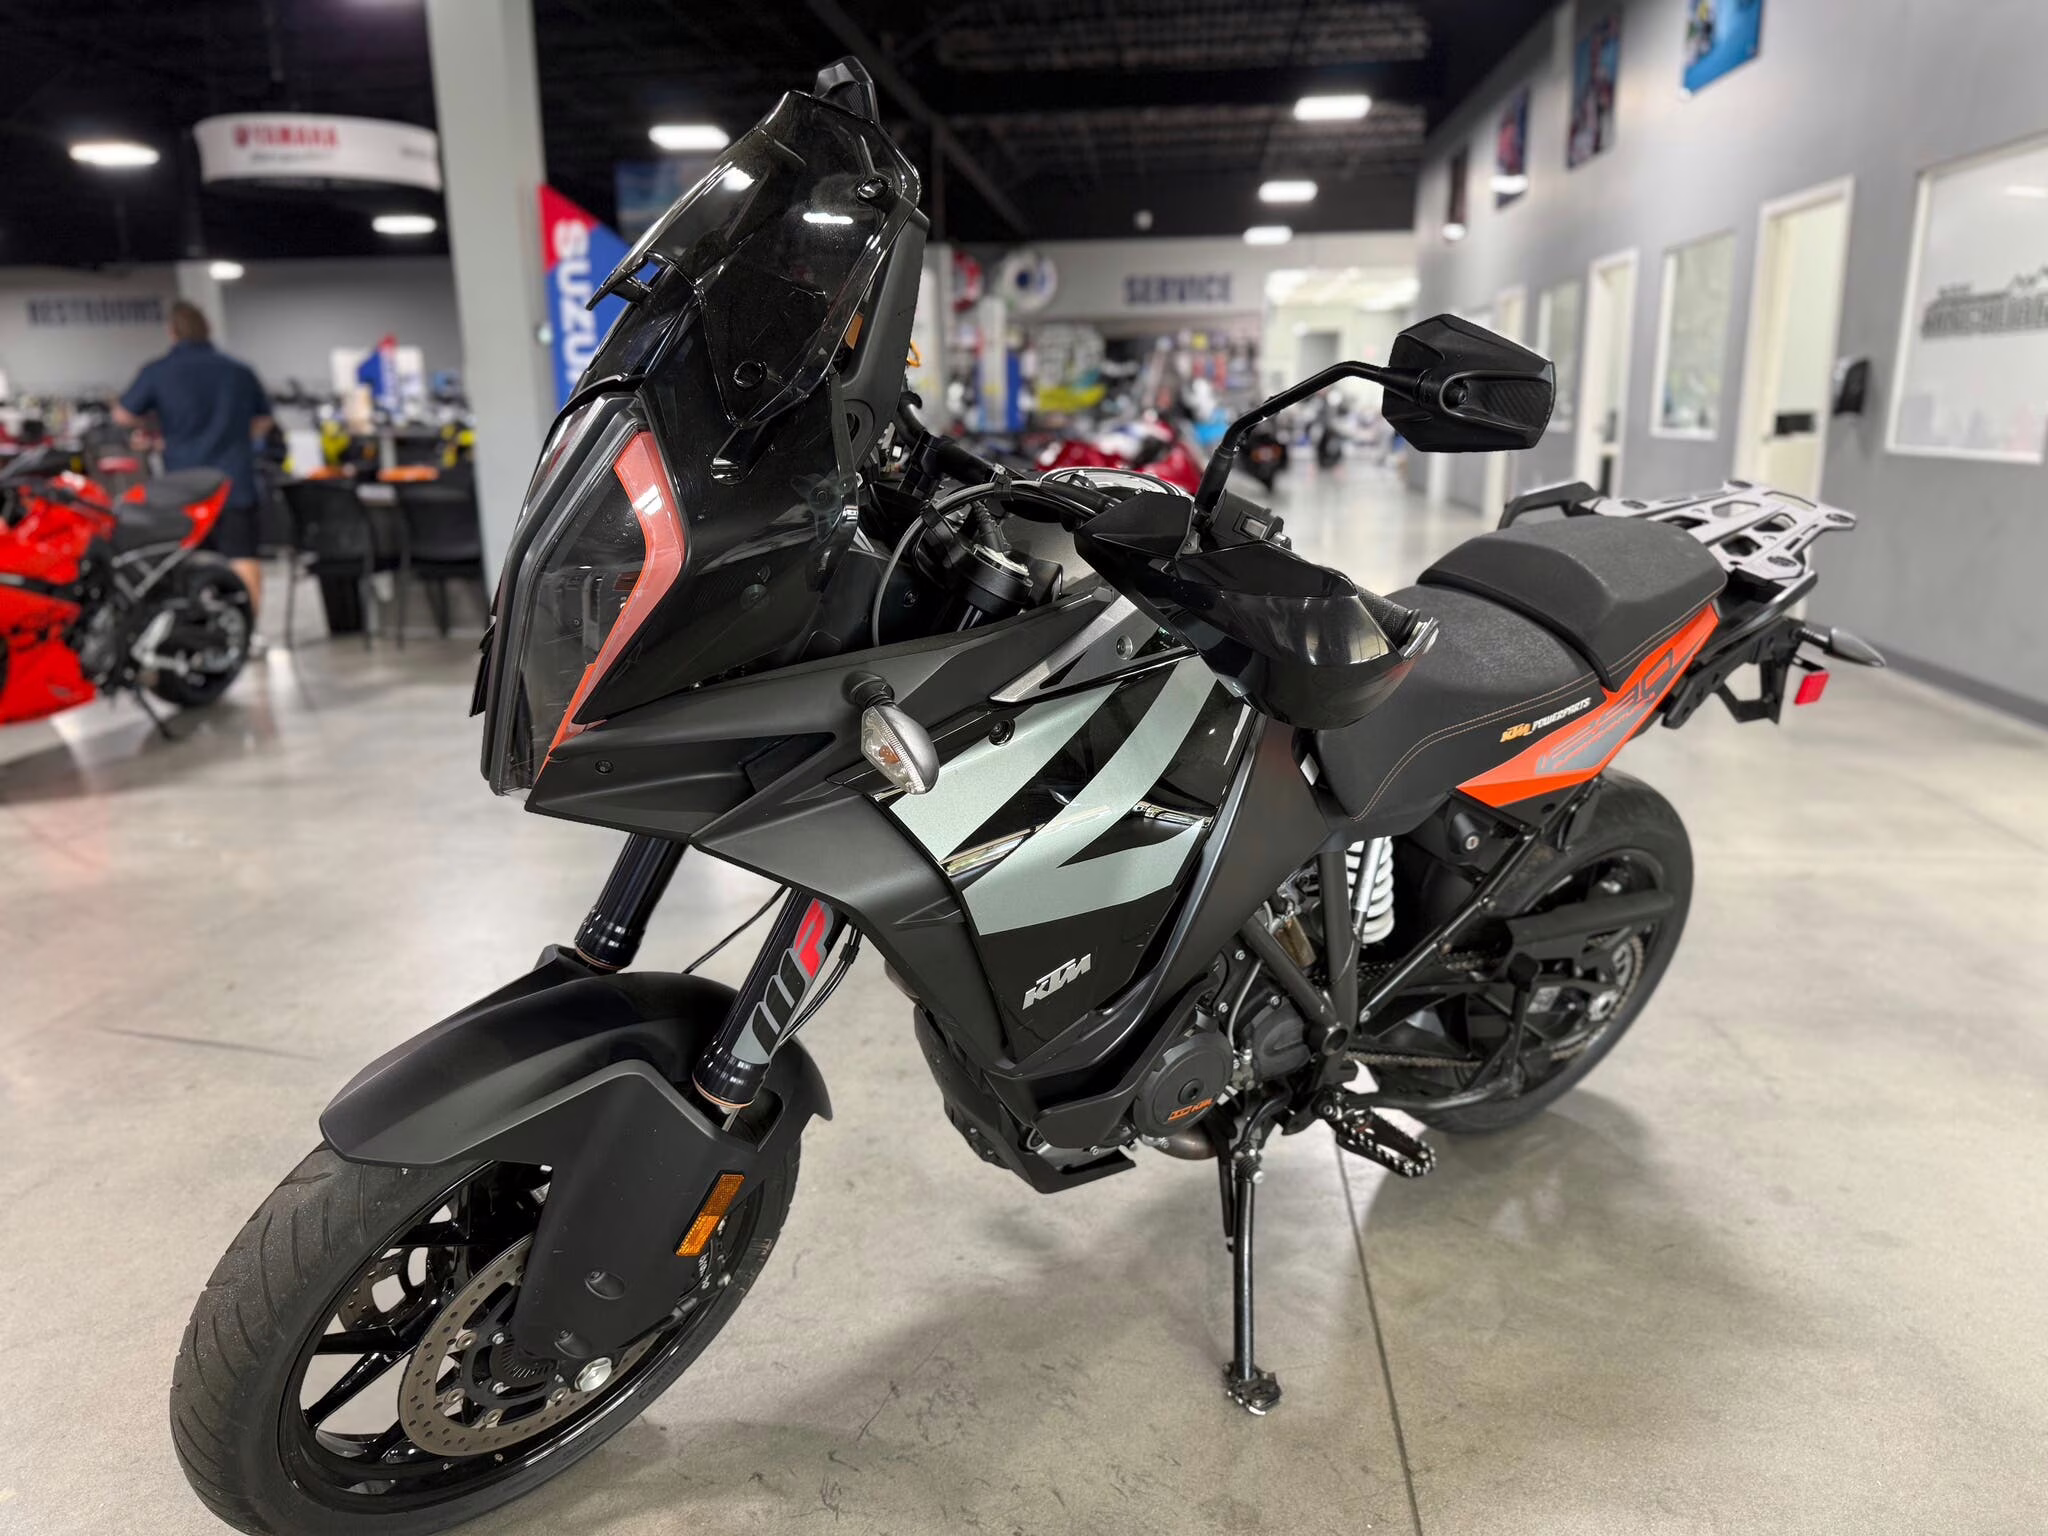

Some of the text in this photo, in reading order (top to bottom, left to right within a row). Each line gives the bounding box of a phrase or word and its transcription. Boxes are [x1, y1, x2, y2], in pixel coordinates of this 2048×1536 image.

[254, 124, 339, 147] YAMAHA
[1125, 274, 1231, 303] SERVICE
[1500, 696, 1592, 743] KTM POWERPARTS
[1022, 953, 1091, 1010] KTM
